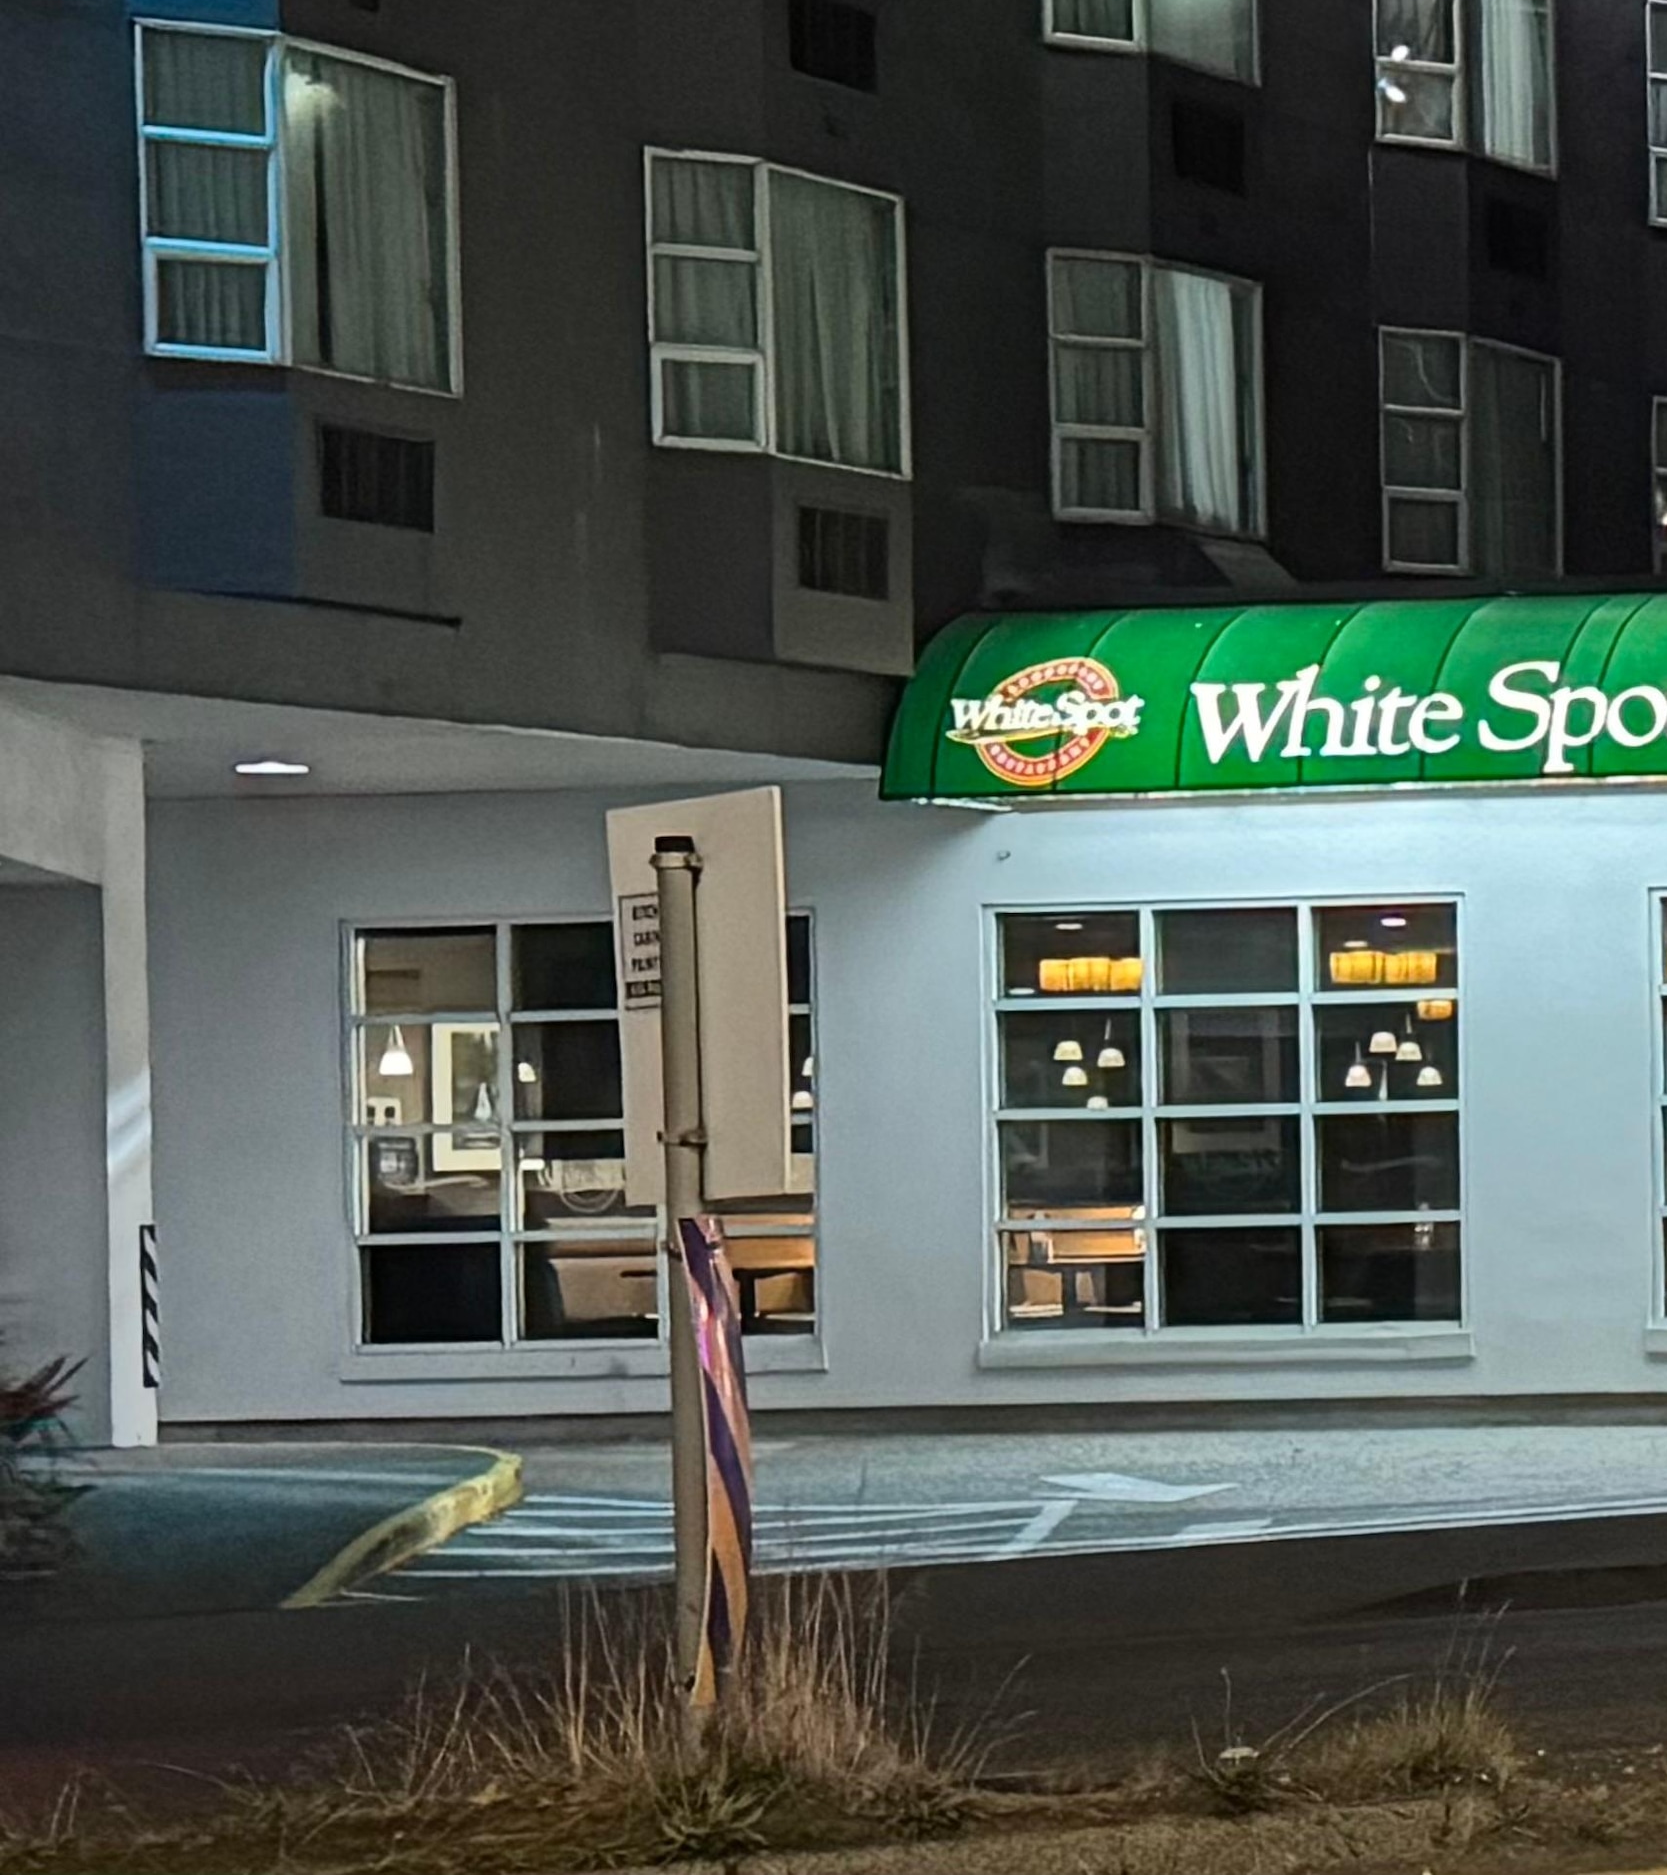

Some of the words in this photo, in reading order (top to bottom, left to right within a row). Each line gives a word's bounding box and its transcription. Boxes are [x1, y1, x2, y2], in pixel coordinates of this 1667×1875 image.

[950, 694, 1053, 730] White
[1054, 689, 1145, 736] Spot
[1190, 663, 1465, 764] White
